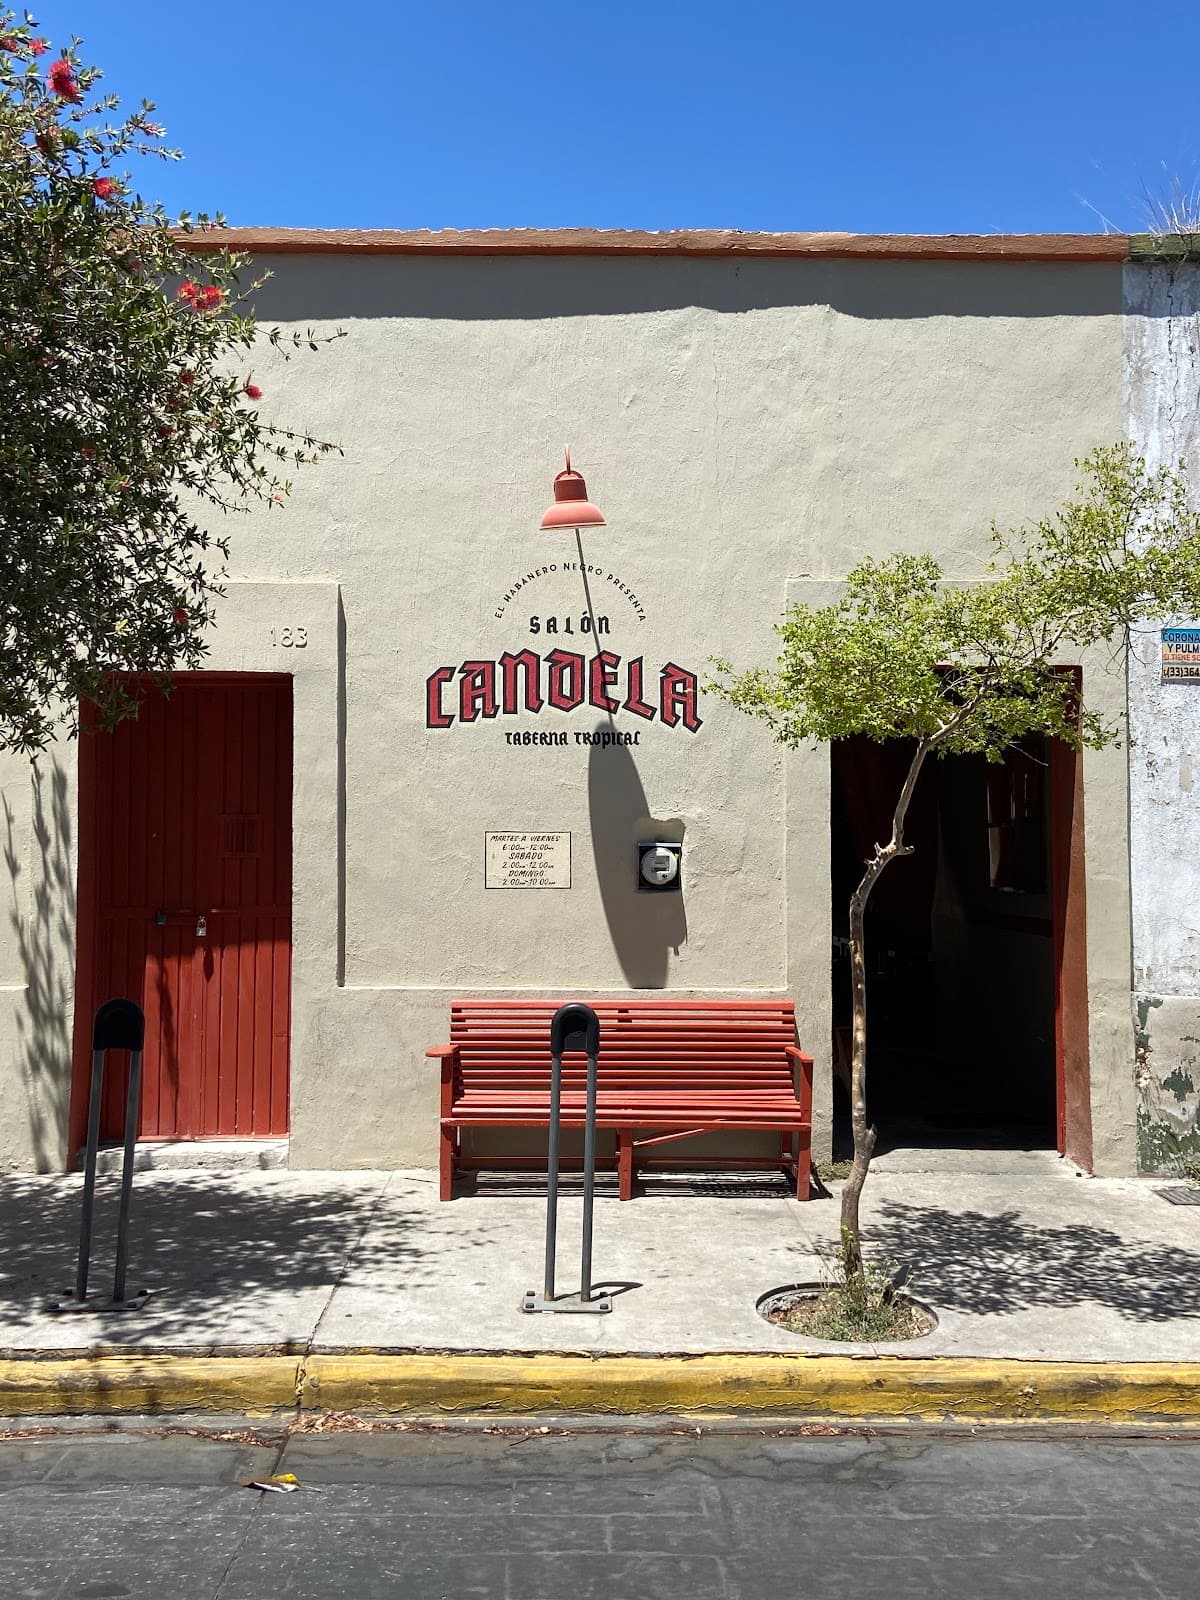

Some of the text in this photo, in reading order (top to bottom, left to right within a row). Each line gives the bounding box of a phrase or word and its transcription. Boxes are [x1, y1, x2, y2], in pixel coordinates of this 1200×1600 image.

[494, 562, 647, 622] EL HABANERO NEGRO PRESENTA
[270, 626, 308, 648] 183
[1163, 632, 1200, 642] CORONA
[1167, 643, 1173, 653] Y
[1171, 653, 1191, 661] TIENE
[426, 647, 704, 734] CANDELA
[504, 731, 641, 749] TABERNA TROPICAL
[508, 870, 545, 878] DOMINGO
